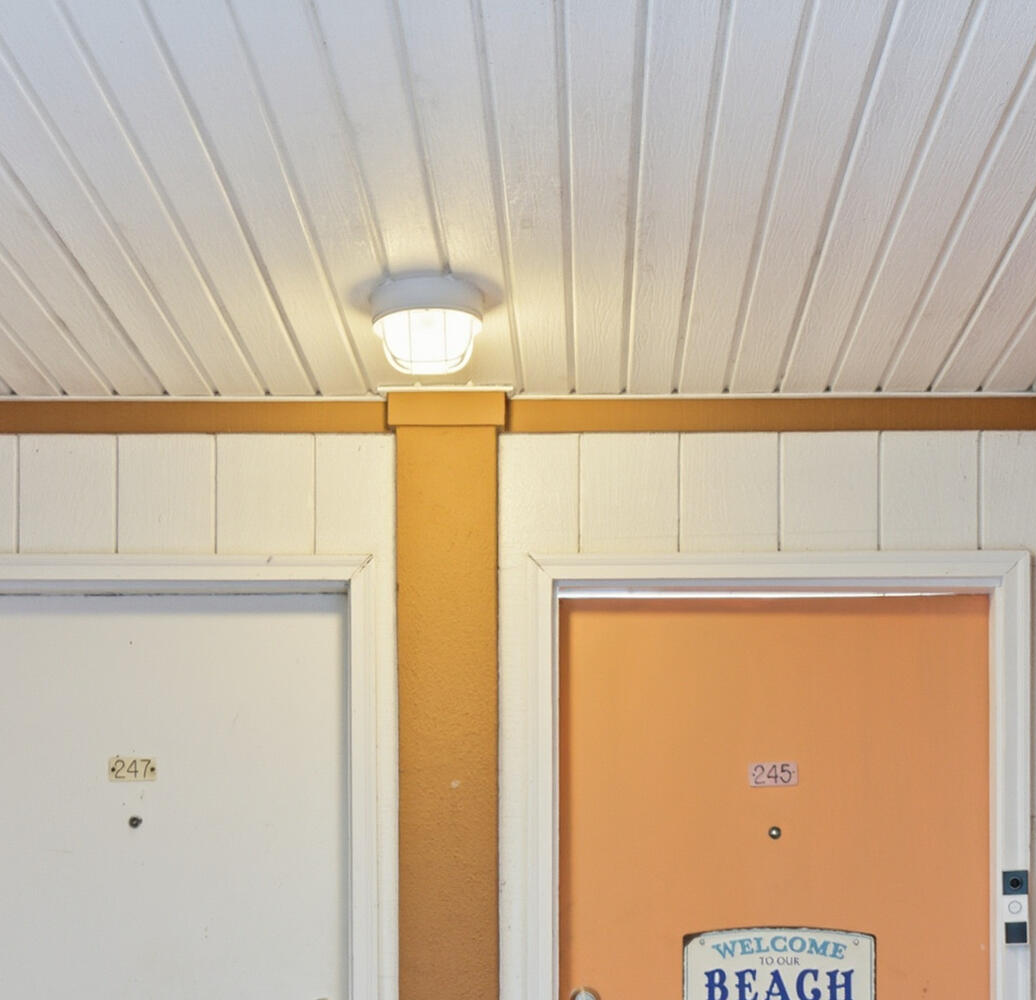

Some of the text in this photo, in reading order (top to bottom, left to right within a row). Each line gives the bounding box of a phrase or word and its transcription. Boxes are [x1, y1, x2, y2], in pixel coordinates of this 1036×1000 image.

[114, 759, 152, 778] 247
[754, 763, 792, 784] 245
[712, 935, 847, 960] WELCOME
[759, 956, 800, 966] TO OUR
